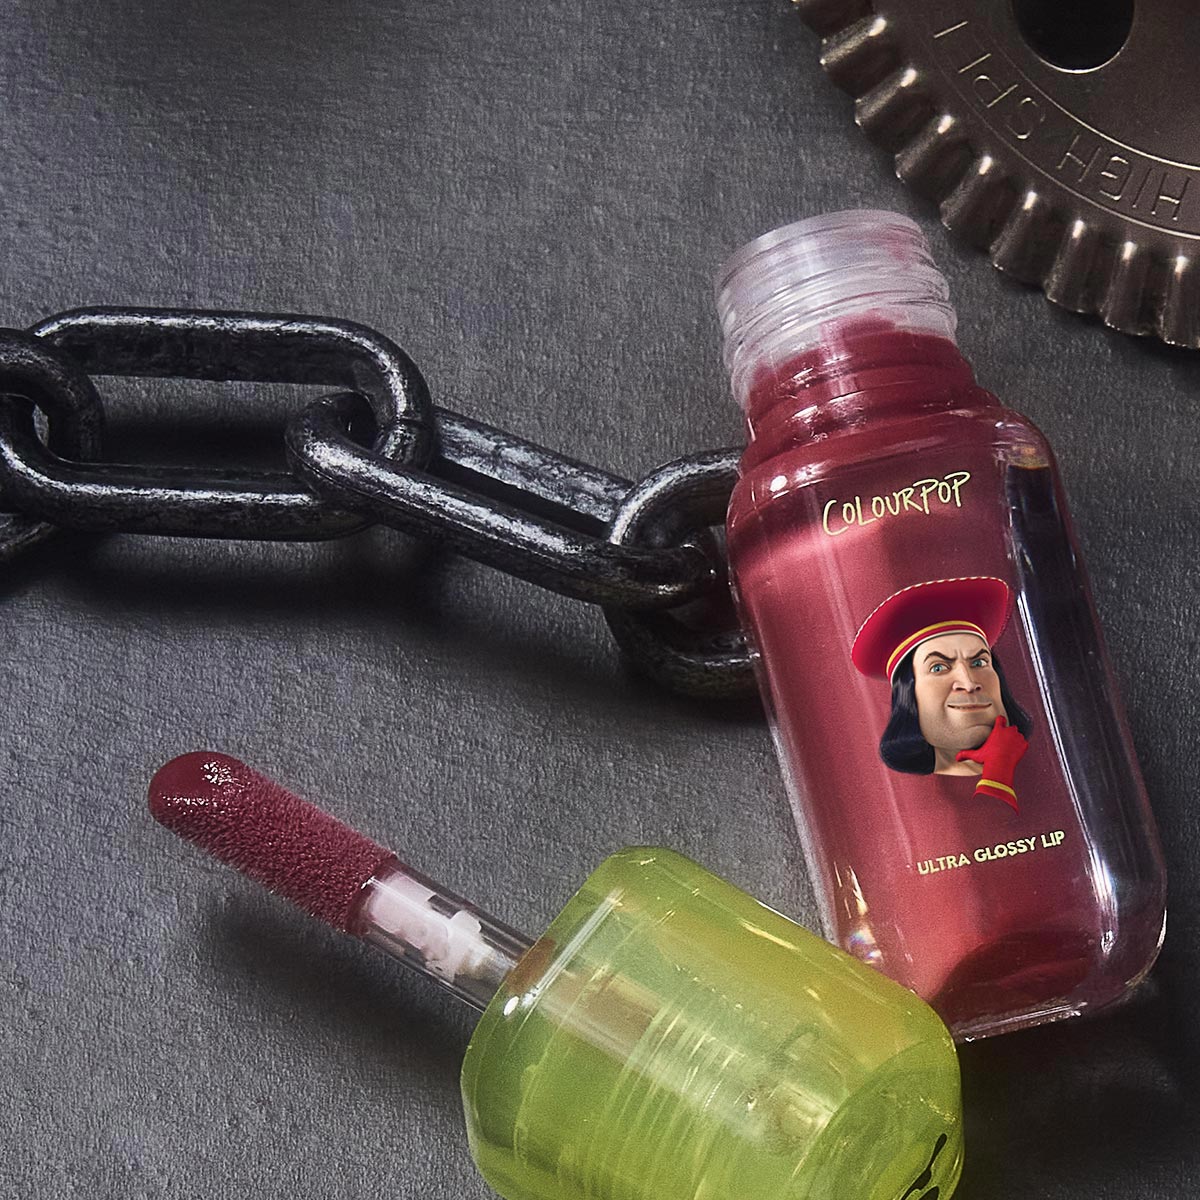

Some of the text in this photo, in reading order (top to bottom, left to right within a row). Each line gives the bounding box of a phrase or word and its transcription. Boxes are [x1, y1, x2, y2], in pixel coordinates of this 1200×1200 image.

[1056, 135, 1190, 221] HIGH
[822, 471, 971, 536] COLOURPOP
[917, 830, 1066, 876] ULTRA GLOSSY LIP
